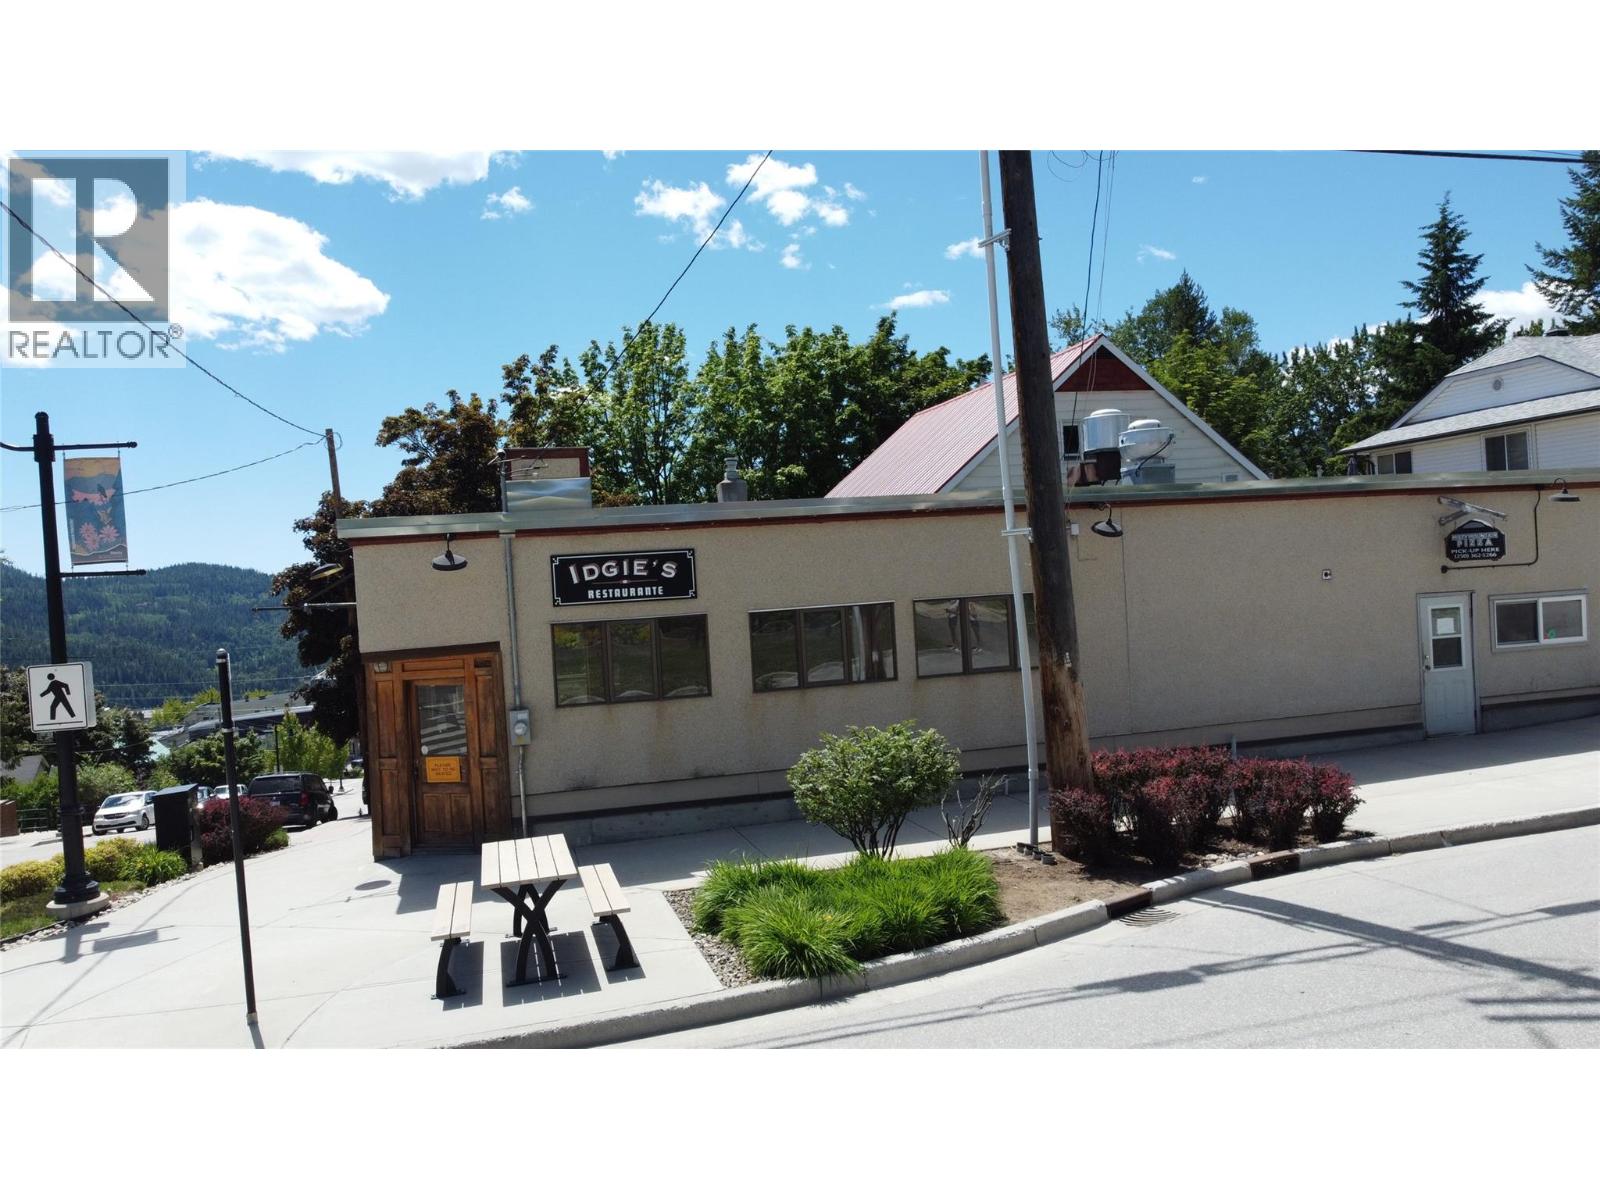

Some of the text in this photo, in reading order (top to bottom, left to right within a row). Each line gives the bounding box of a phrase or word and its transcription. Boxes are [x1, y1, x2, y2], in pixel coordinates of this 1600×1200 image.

[1457, 538, 1494, 548] PIZZA
[568, 558, 679, 585] IDGIE'S
[587, 585, 665, 600] RESTAURANTE
